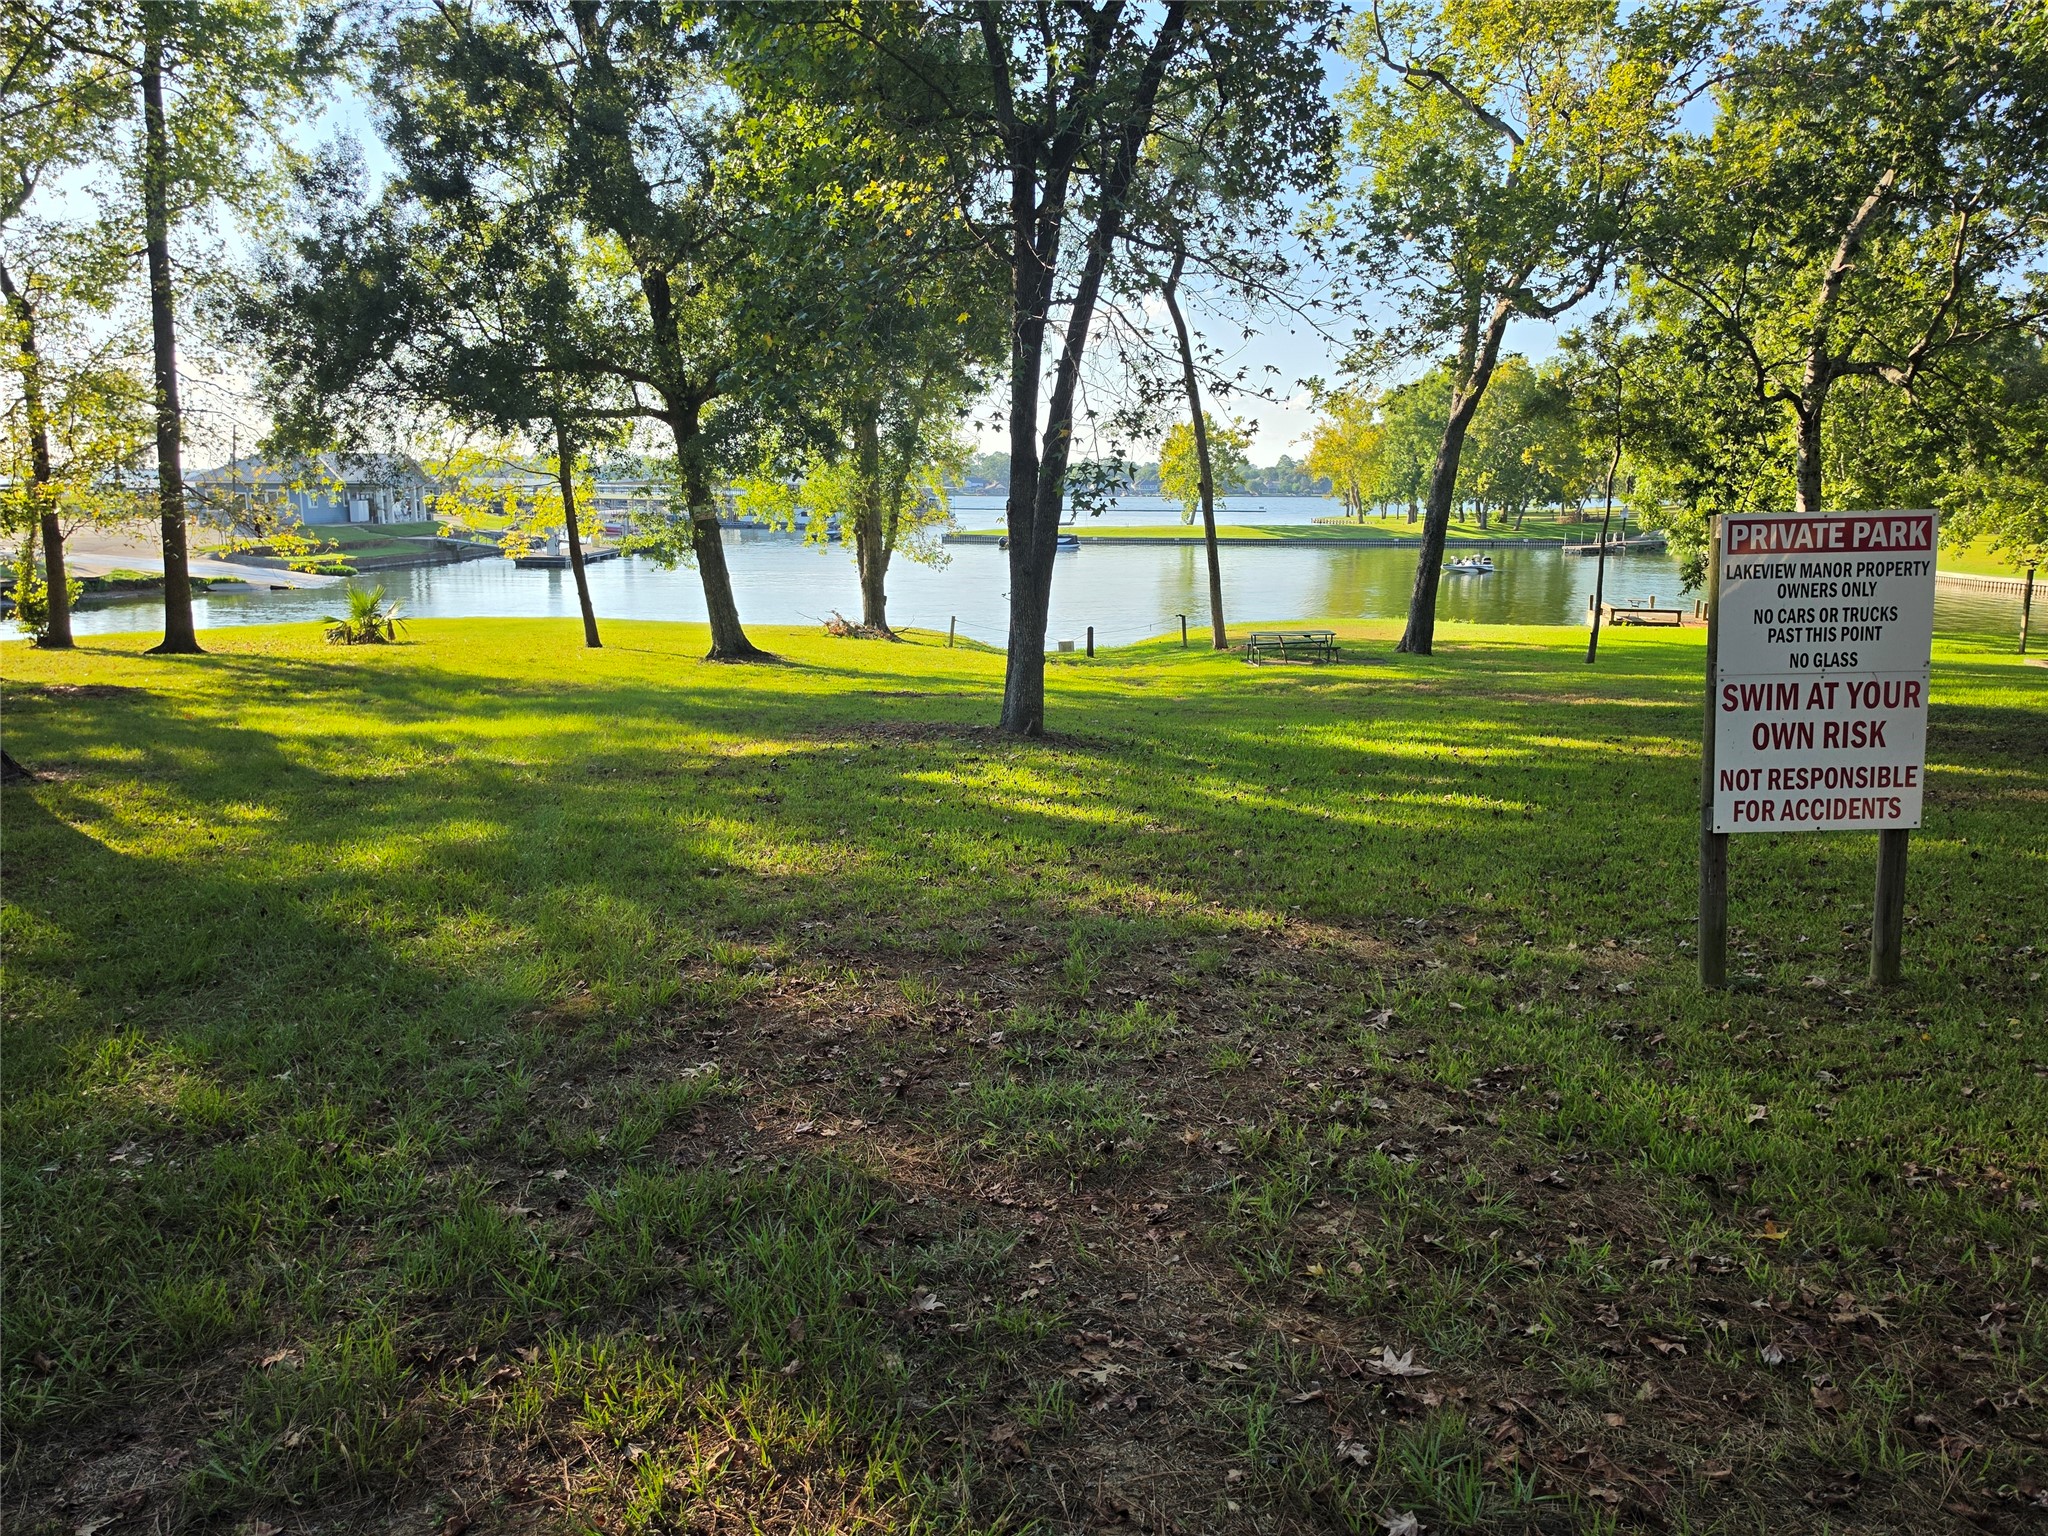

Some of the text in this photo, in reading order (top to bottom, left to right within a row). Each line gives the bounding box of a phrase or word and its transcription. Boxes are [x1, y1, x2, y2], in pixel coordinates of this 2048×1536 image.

[1731, 520, 1928, 550] PRIVATE PARK
[1726, 561, 1930, 579] LAKEVIEW MANOR PROPERTY
[1778, 582, 1877, 598] OWNERS ONLY
[1754, 606, 1898, 624] NO CARS OR TRUCKS
[1768, 626, 1882, 643] PAST THIS POINT
[1790, 652, 1858, 668] NO GLASS
[1722, 681, 1921, 712] SWIM AT YOUR
[1753, 721, 1887, 750] OWN RISK
[1720, 766, 1917, 791] NOT RESPONSIBLE
[1734, 797, 1901, 822] FOR ACCIDENTS
